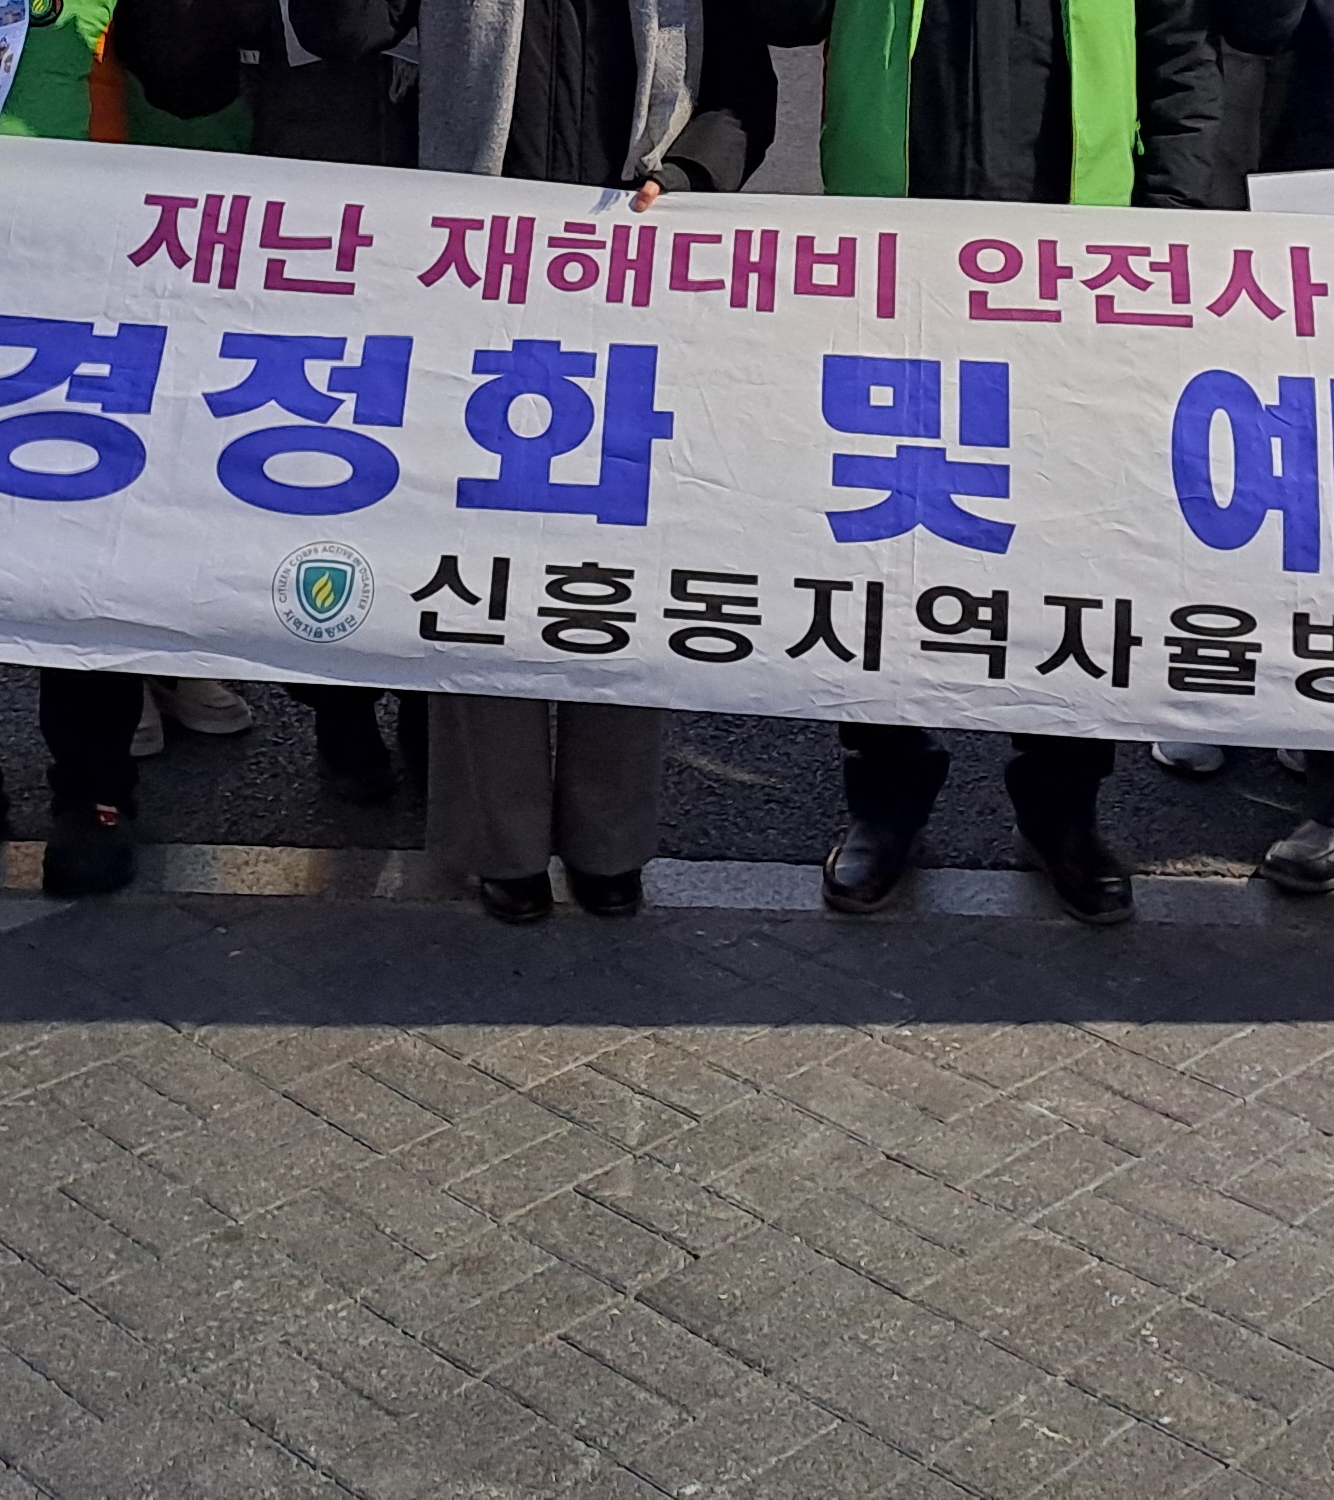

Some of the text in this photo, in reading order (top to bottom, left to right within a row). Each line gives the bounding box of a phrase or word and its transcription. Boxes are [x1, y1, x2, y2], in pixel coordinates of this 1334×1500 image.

[127, 192, 374, 296] 재난
[418, 214, 899, 319] 재해대비
[821, 352, 1017, 555] 및
